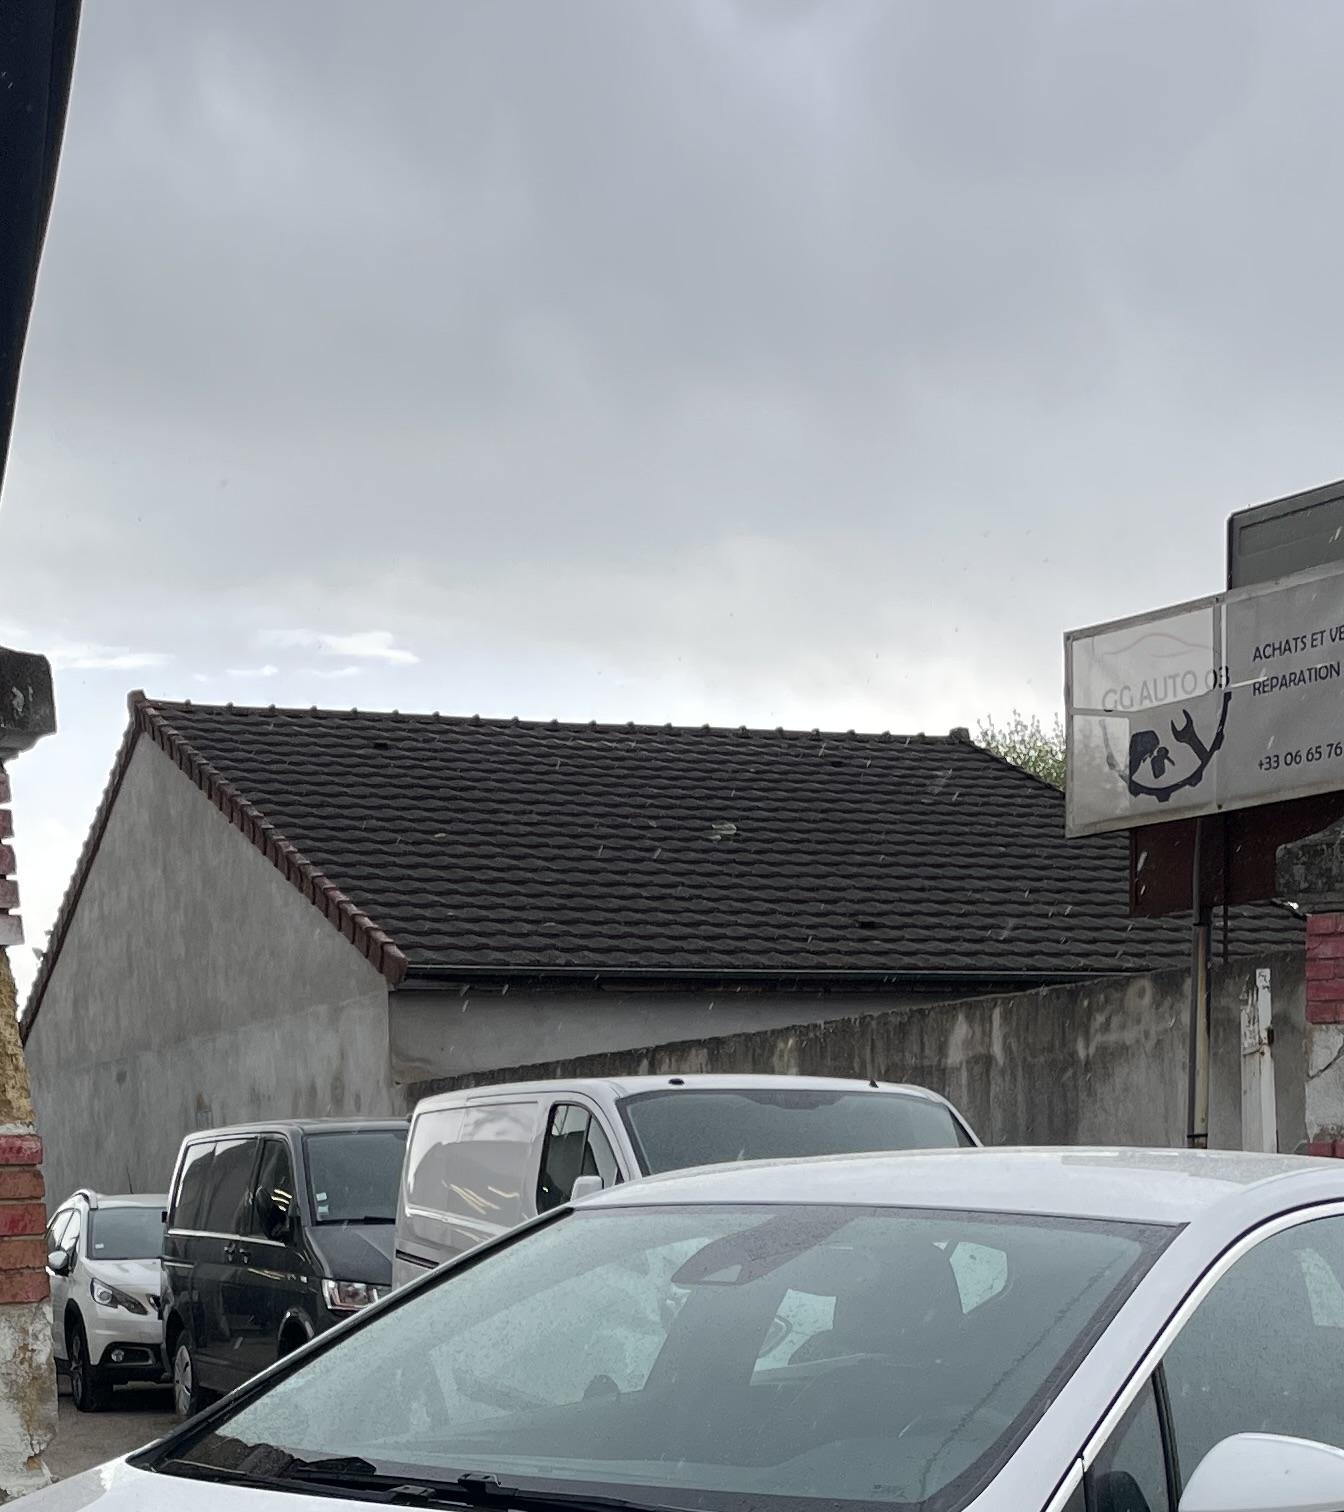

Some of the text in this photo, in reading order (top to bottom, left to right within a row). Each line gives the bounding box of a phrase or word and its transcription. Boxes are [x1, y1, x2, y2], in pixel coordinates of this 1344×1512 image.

[1252, 634, 1307, 662] ACHATS
[1310, 630, 1326, 649] ET
[1140, 670, 1197, 706] AUTO
[1252, 661, 1341, 696] REPARATION
[1258, 754, 1280, 771] +33
[1284, 750, 1302, 766] 06
[1306, 745, 1322, 762] 65
[1326, 742, 1343, 758] 76
